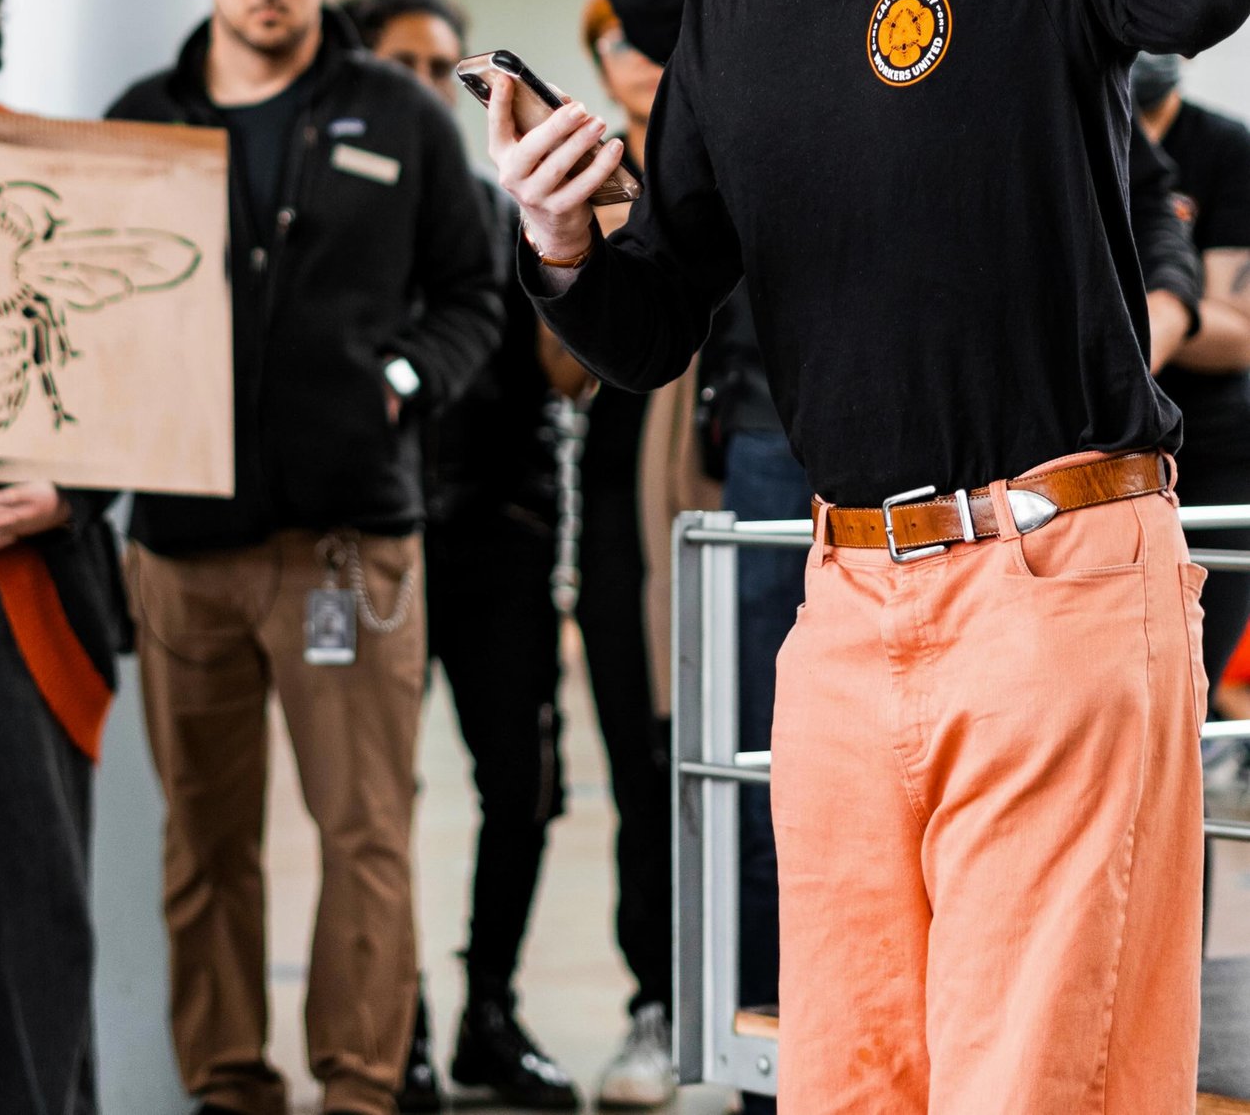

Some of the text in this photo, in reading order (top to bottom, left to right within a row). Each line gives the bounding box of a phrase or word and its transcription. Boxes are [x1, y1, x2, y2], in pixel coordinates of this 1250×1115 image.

[876, 0, 890, 20] CAL
[936, 4, 944, 33] 1021
[874, 37, 943, 81] WORKERS UNITED
